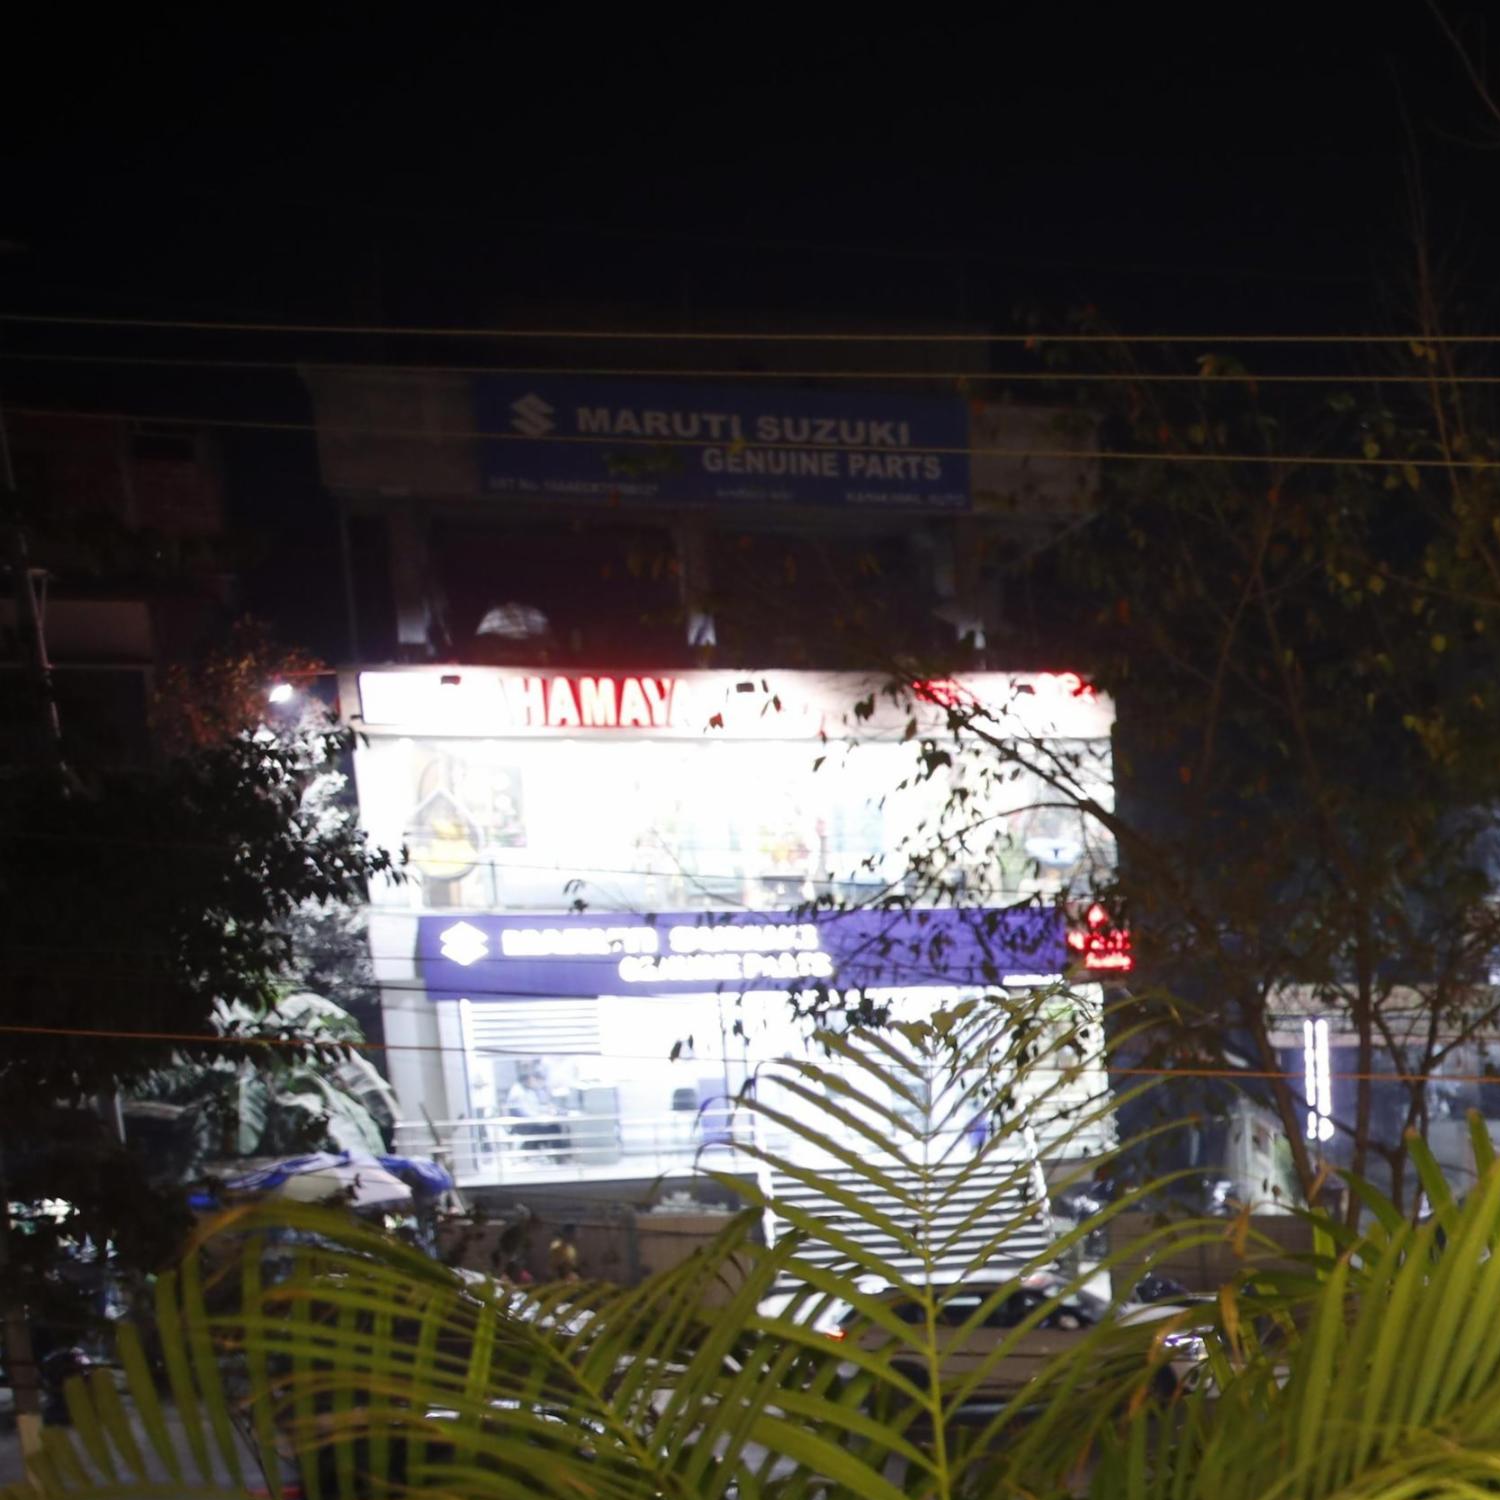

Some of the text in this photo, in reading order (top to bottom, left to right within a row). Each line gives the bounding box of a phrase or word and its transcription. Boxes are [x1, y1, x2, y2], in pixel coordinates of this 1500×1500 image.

[576, 407, 911, 447] MARUTI SUZUKI
[701, 446, 943, 481] GENUINE PARTS
